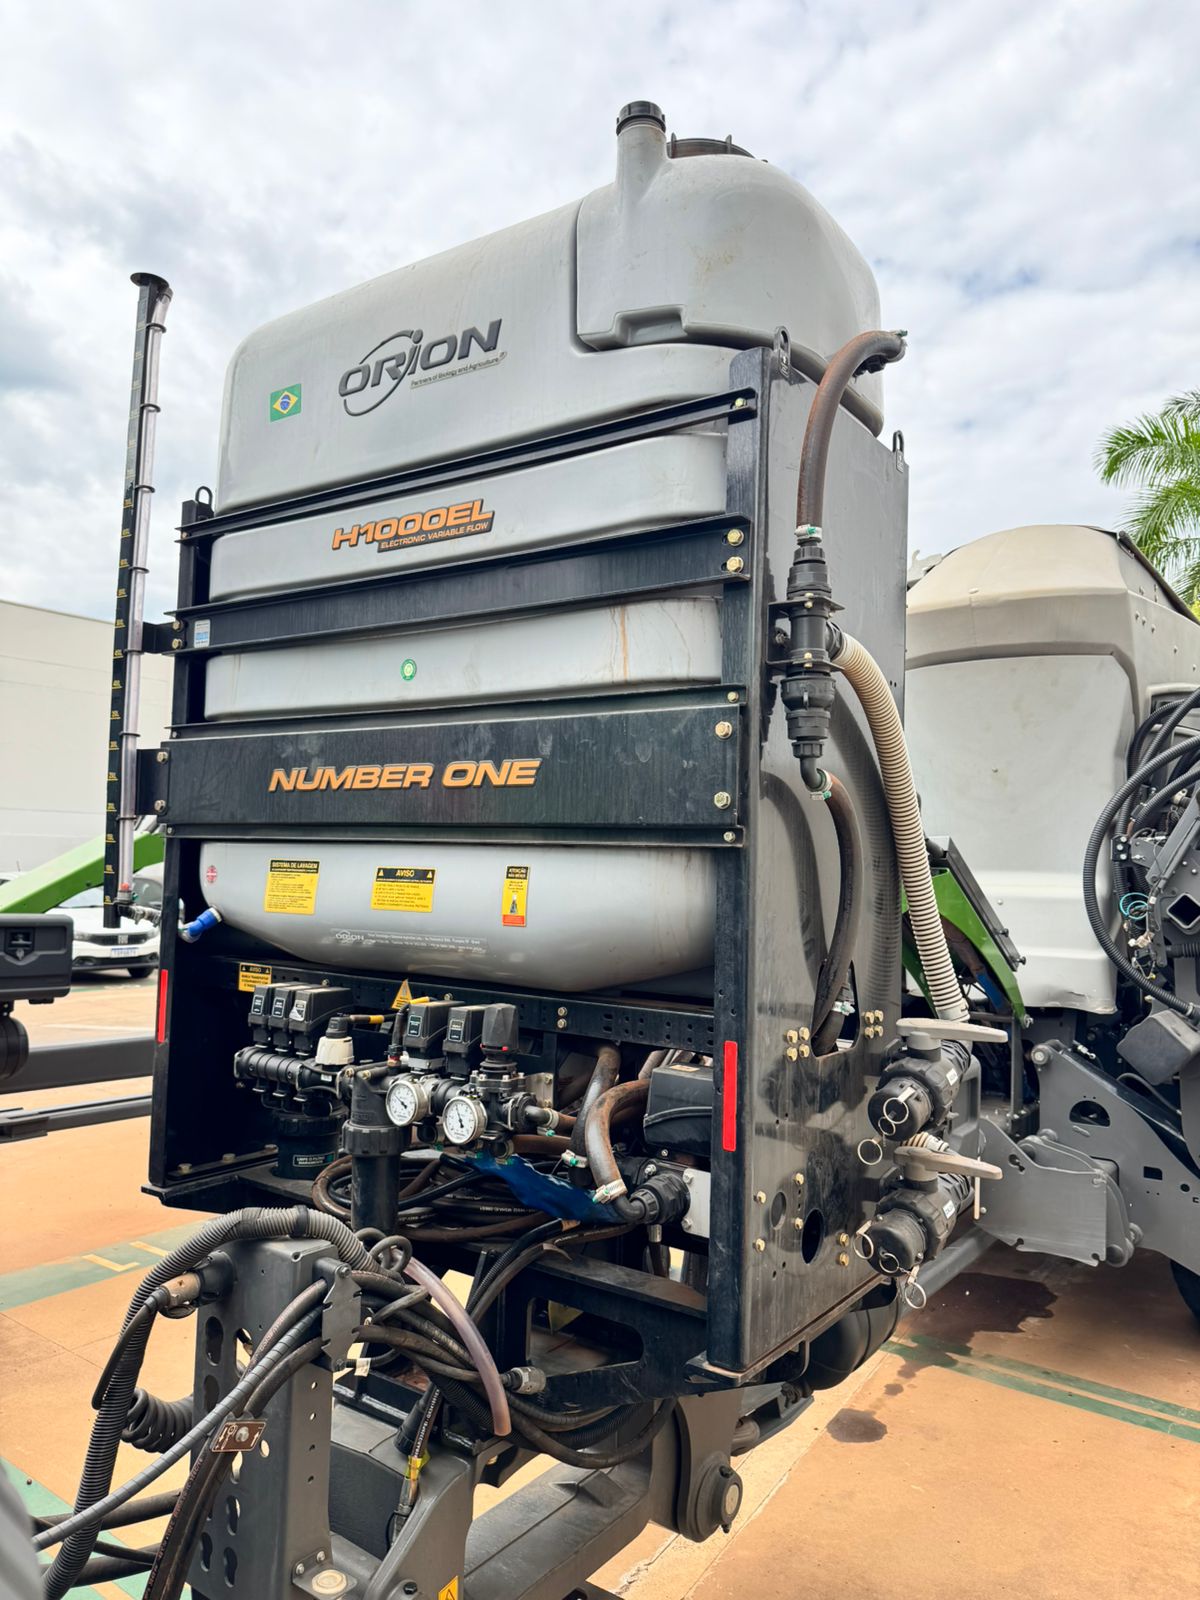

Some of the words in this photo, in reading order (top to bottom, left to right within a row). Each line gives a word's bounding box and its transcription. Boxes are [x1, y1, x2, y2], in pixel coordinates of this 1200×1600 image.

[332, 499, 494, 550] H1000EL
[381, 534, 426, 549] ELECTRONIC
[427, 526, 465, 540] VARIABLE
[466, 521, 489, 533] FLOW
[269, 763, 434, 792] NUMBER
[441, 758, 543, 788] ONE
[395, 869, 415, 877] AVISO
